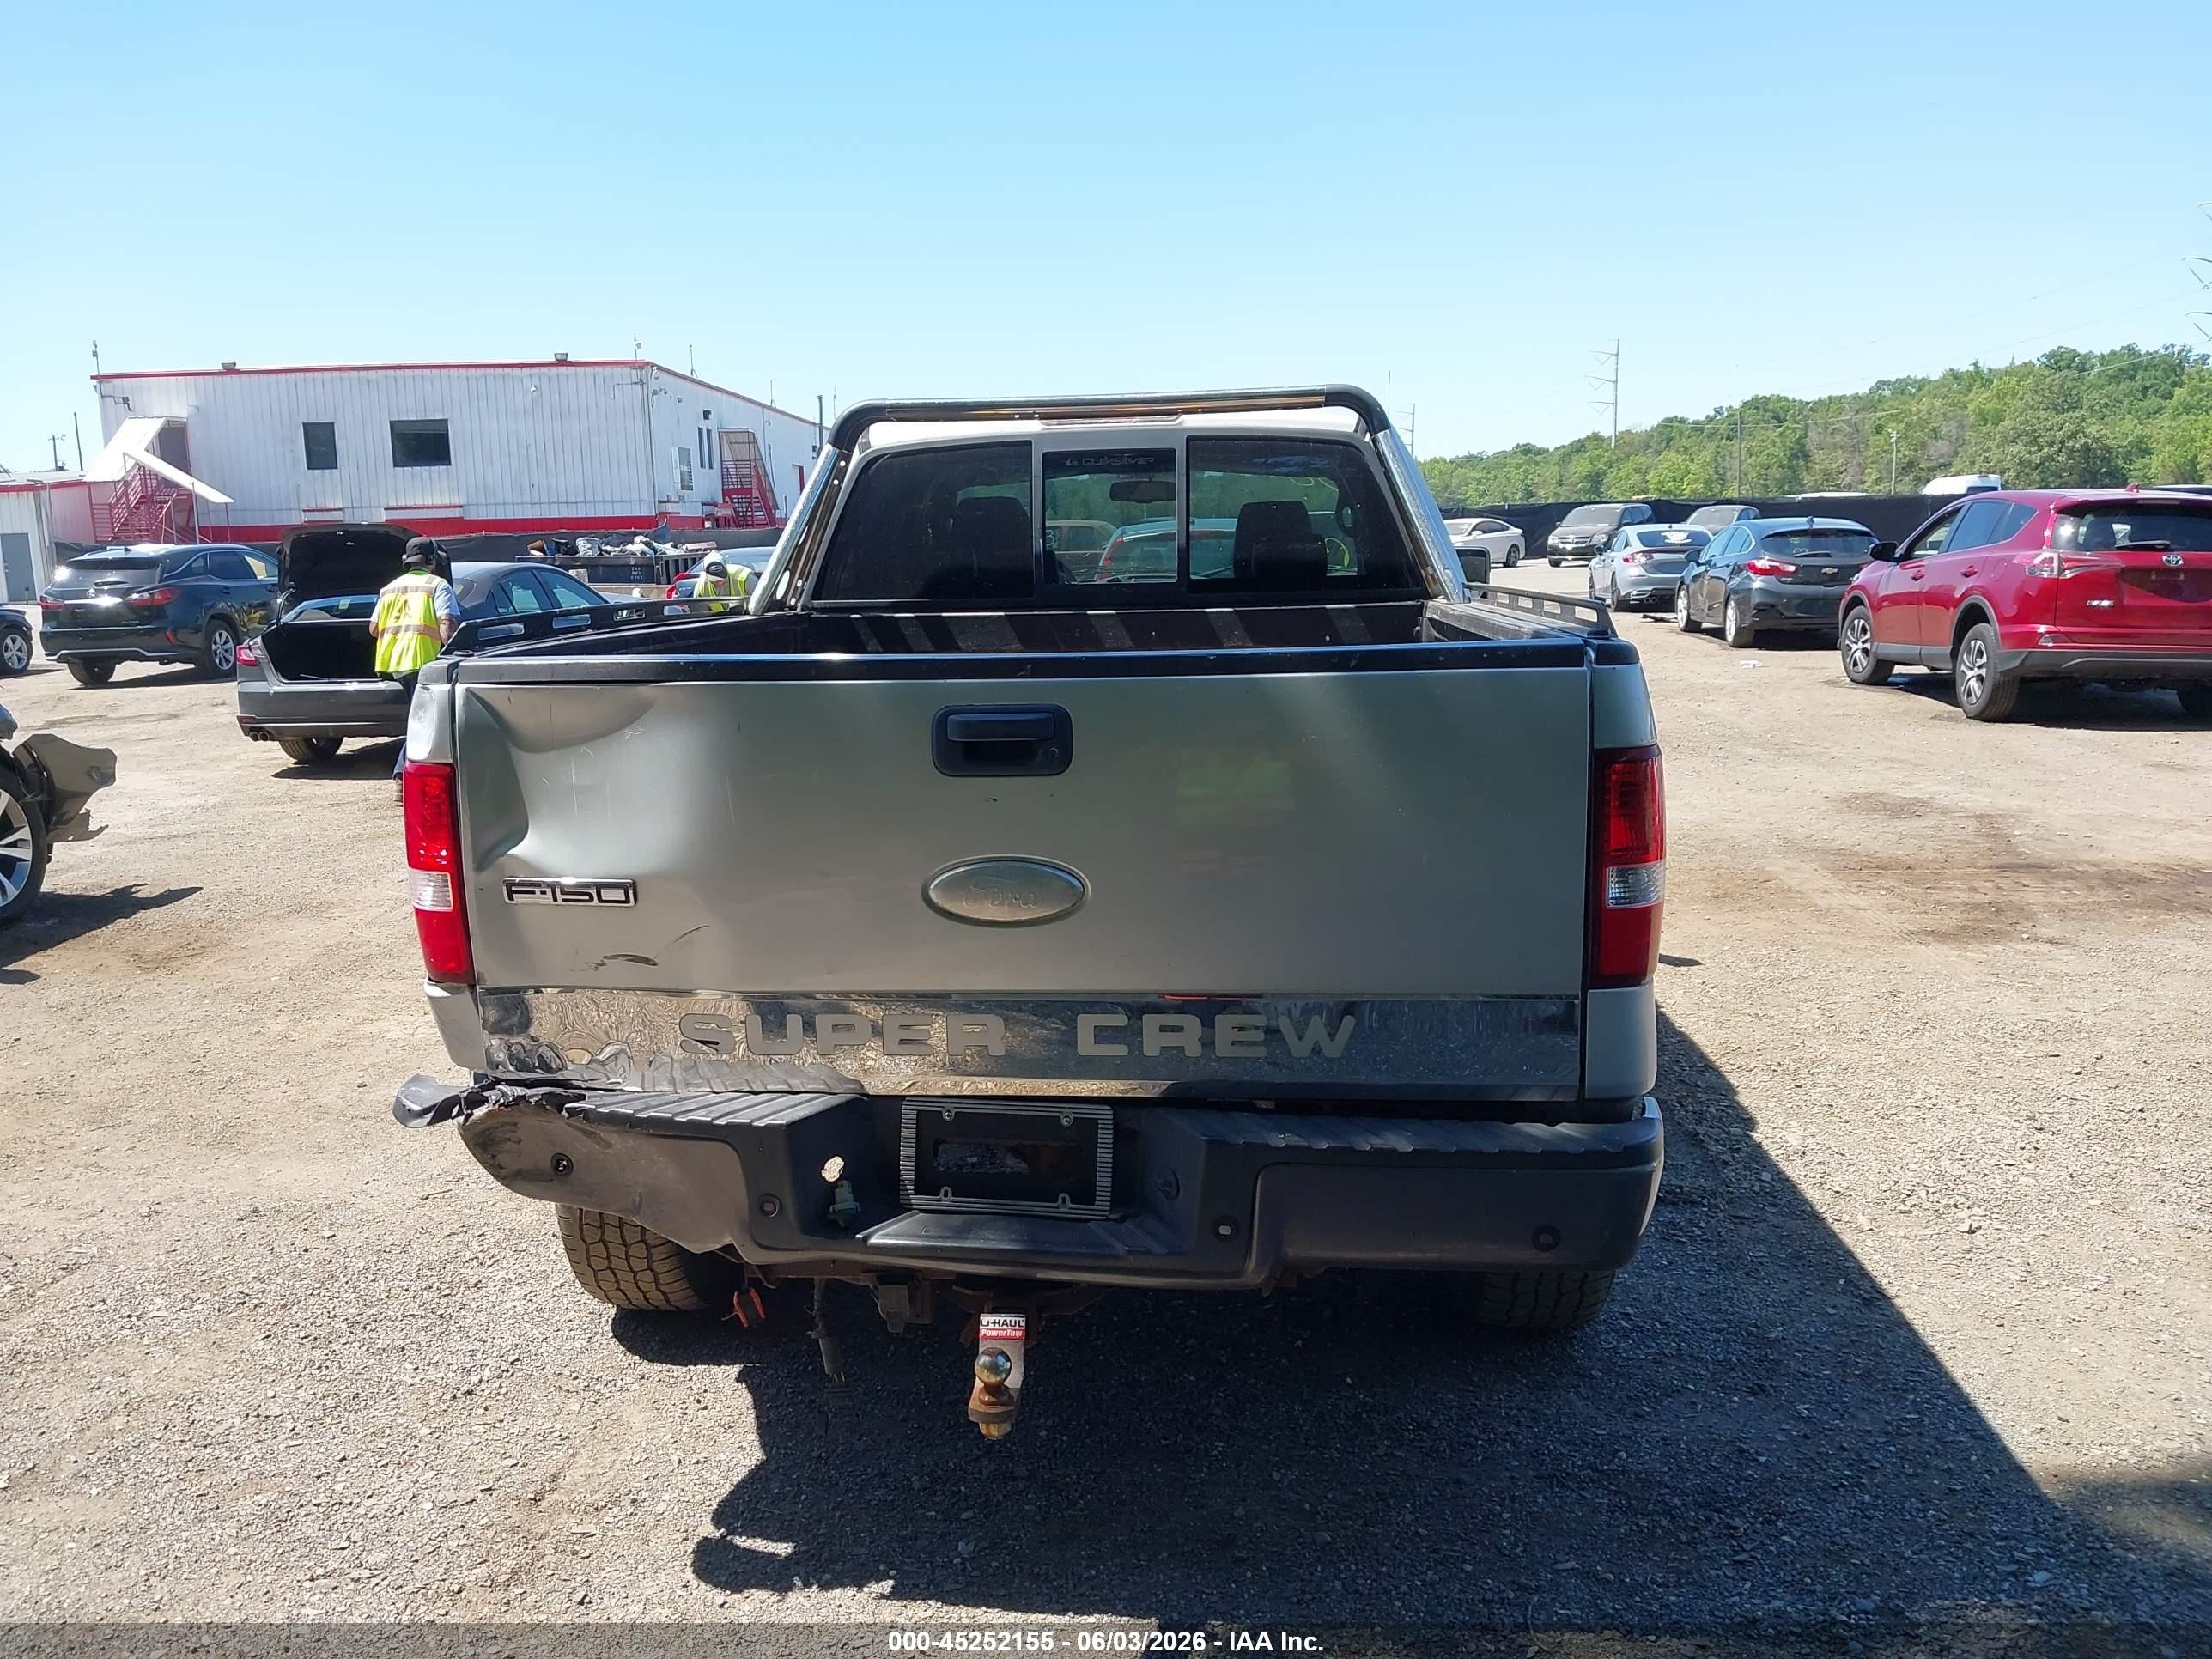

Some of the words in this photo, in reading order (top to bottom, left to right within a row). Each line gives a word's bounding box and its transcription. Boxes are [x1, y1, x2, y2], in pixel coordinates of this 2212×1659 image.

[504, 881, 631, 904] F-150
[679, 1013, 1006, 1056] SUPER
[1077, 1013, 1356, 1057] CREW
